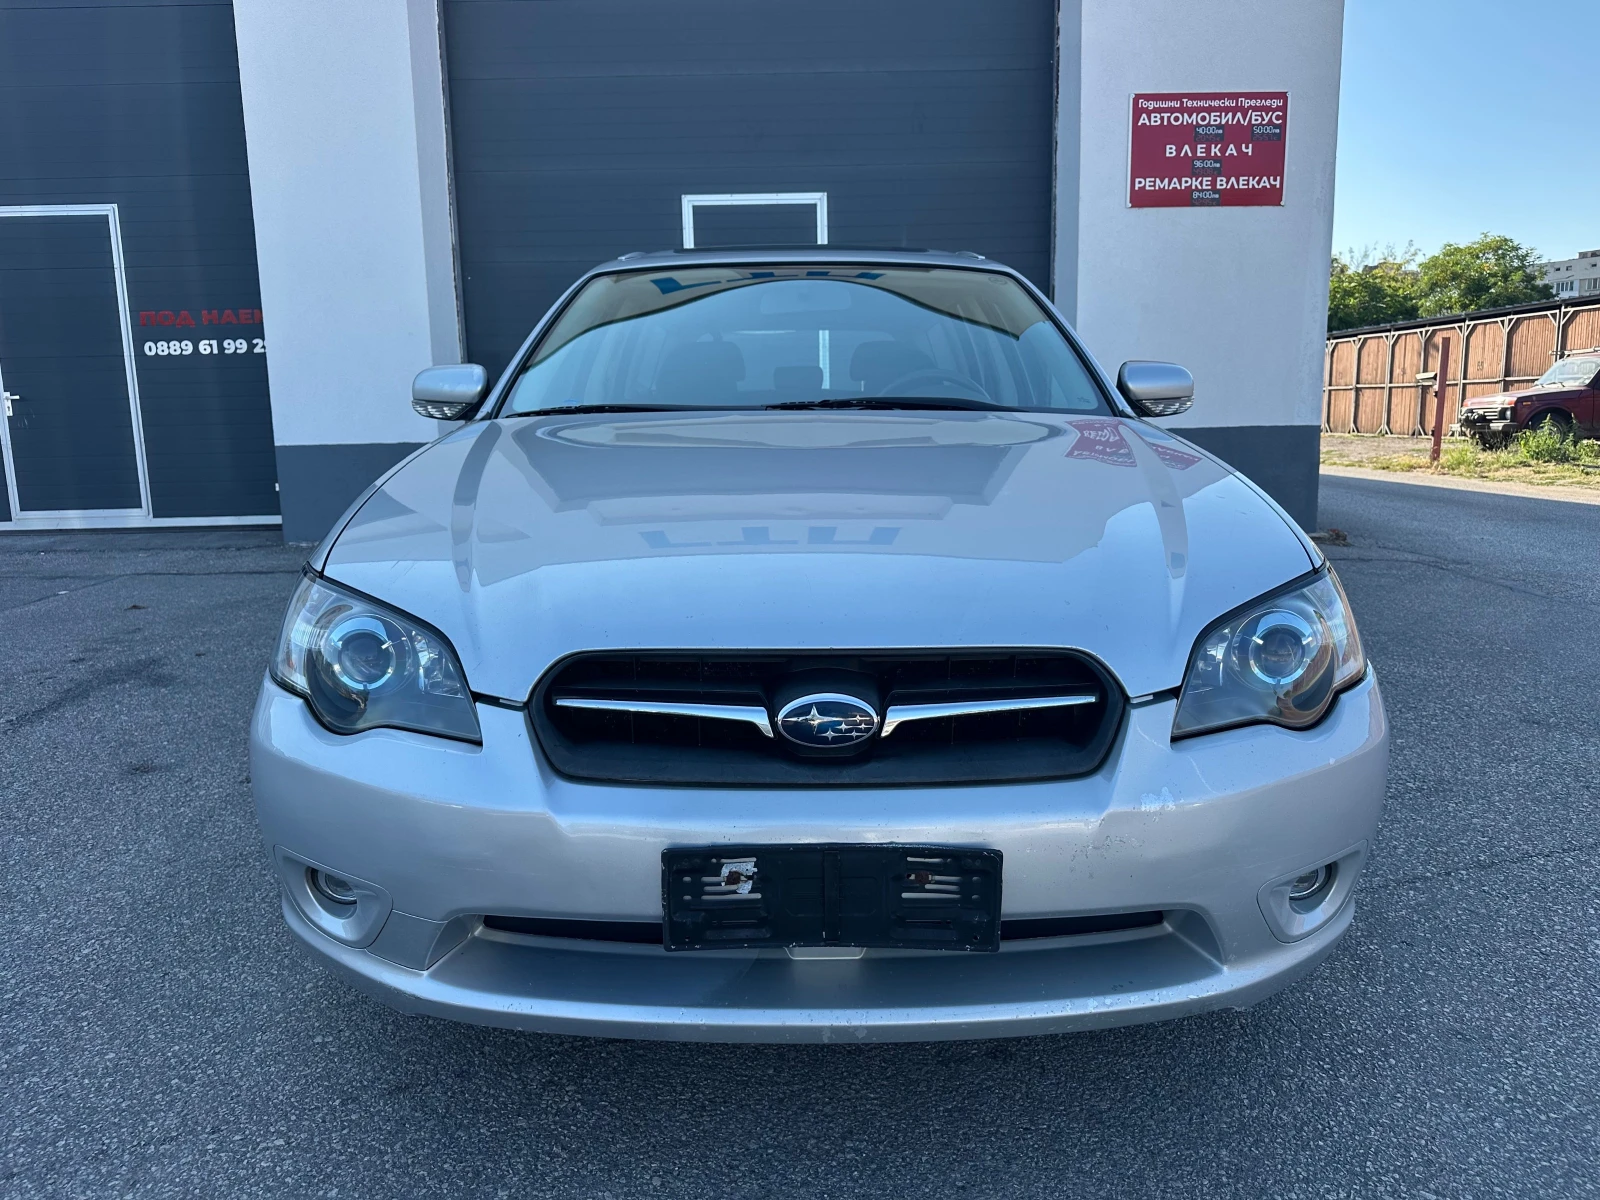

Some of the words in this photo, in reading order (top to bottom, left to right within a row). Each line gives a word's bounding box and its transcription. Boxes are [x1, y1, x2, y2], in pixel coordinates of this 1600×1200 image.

[1138, 98, 1180, 109] Годишни
[1182, 98, 1236, 107] Технически
[1238, 97, 1283, 108] Прегледи
[1138, 110, 1283, 126] АВТОМОБИЛ/БУС
[1135, 177, 1211, 190] РЕМАРКЕ
[1216, 176, 1281, 189] ВЛЕКАЧ
[139, 311, 196, 327] ПОД
[144, 340, 194, 356] 0889
[198, 339, 219, 355] 61
[223, 338, 248, 354] 99
[252, 338, 267, 354] 2
